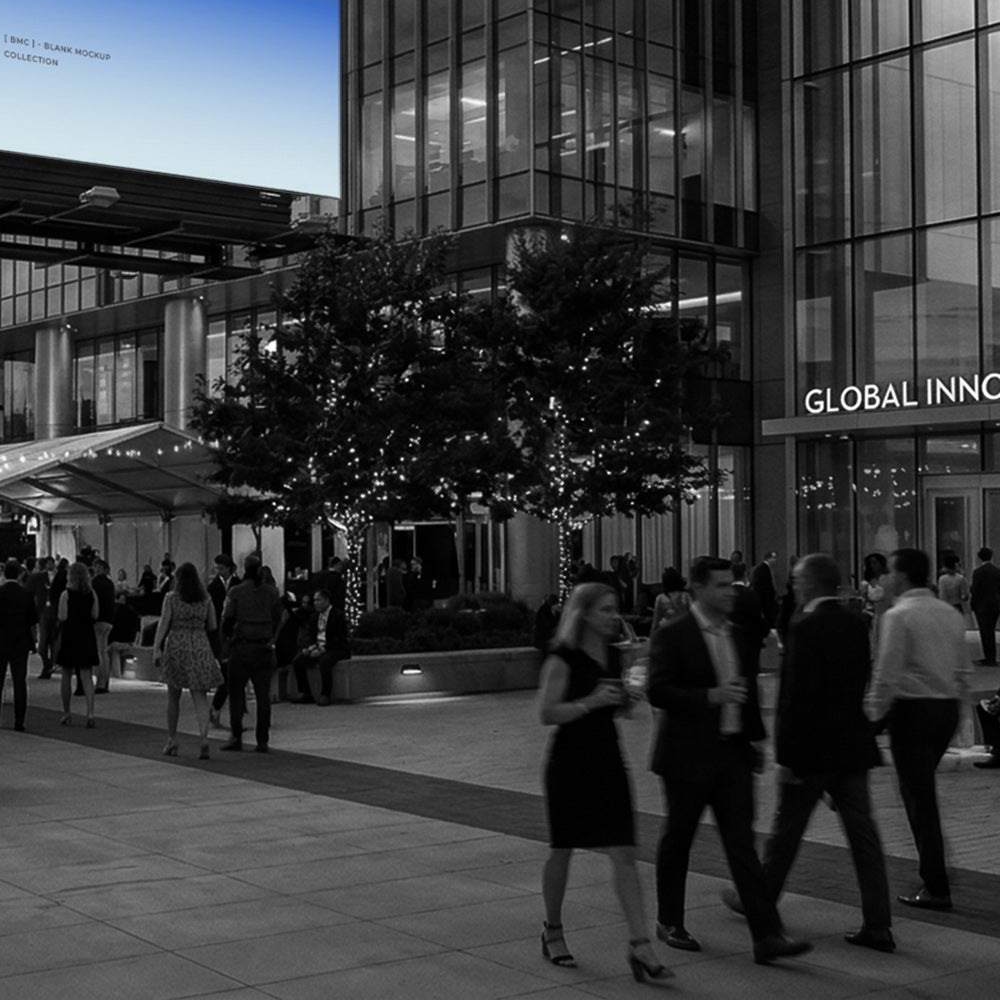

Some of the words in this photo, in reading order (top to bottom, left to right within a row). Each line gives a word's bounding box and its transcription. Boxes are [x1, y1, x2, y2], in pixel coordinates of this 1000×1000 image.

[3, 50, 59, 67] COLLECTION
[10, 35, 30, 47] BMC
[43, 41, 73, 55] BLANK
[74, 48, 111, 61] MOCKUP
[804, 381, 918, 414] GLOBAL
[926, 373, 1000, 405] INNO
